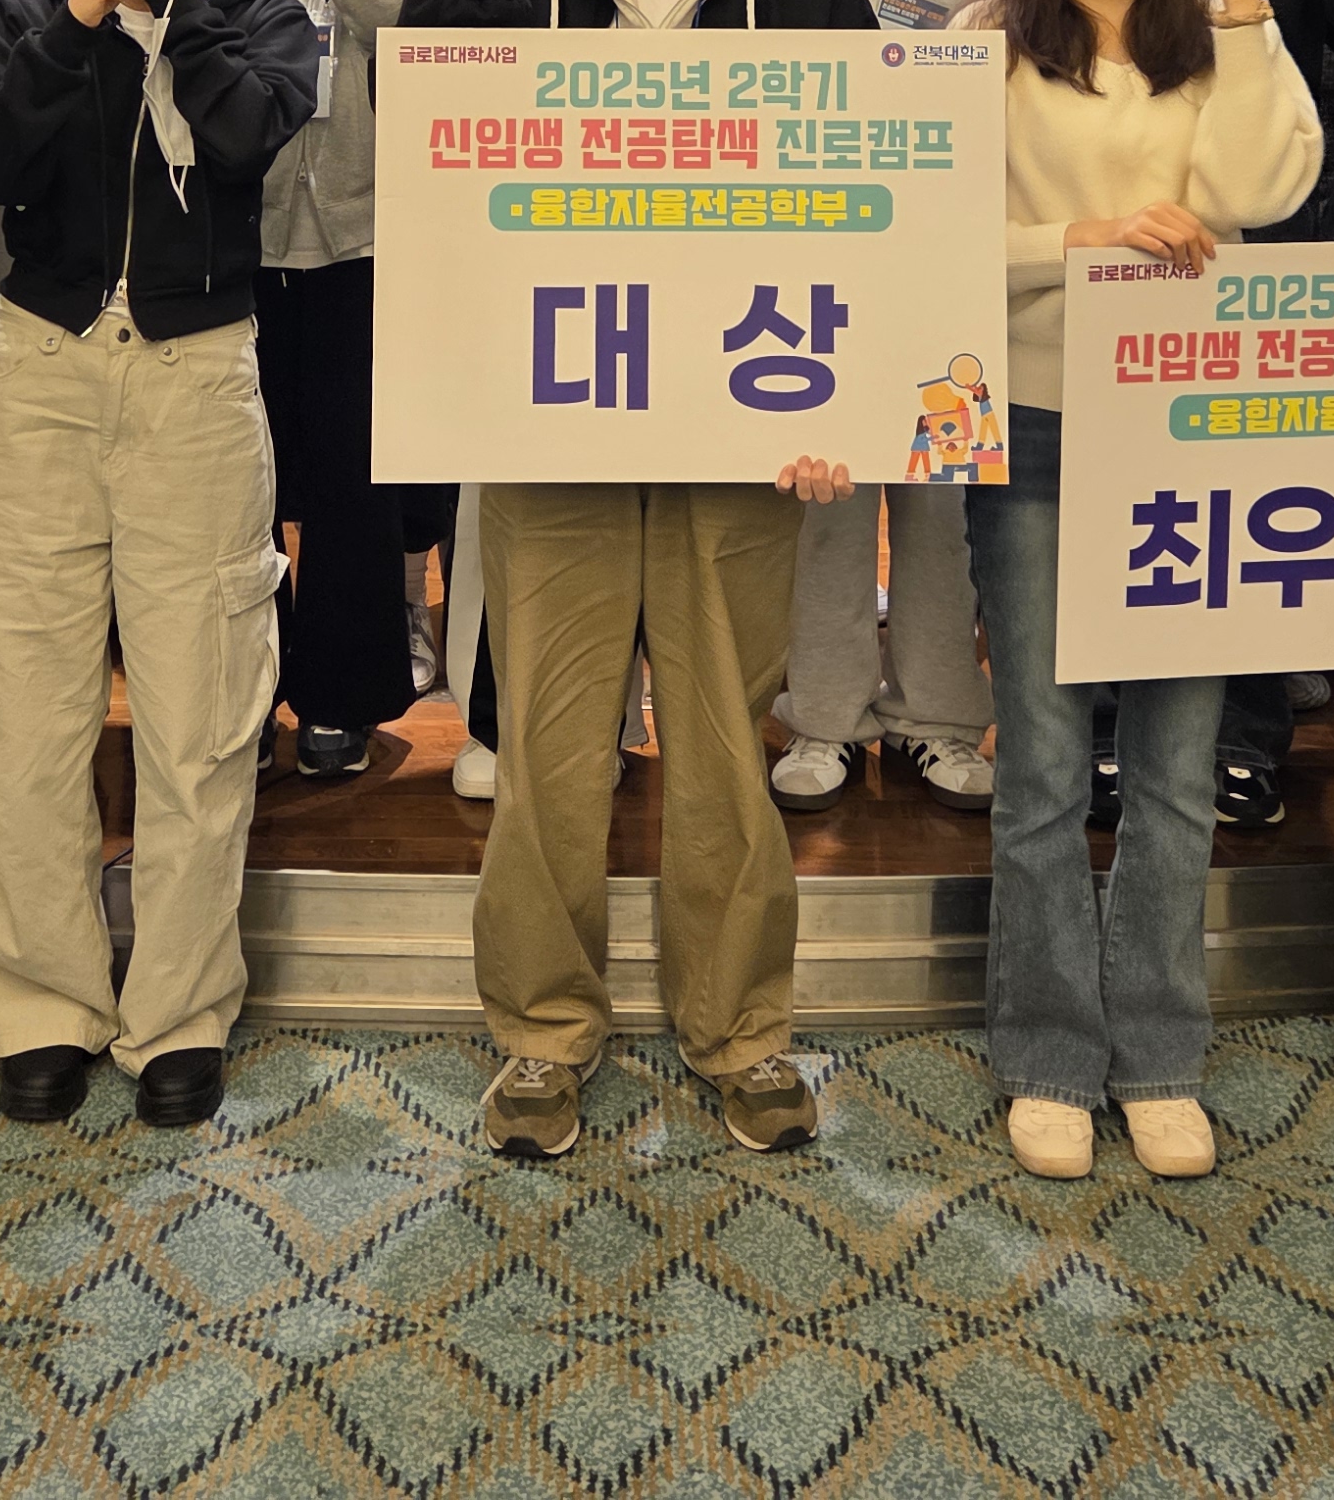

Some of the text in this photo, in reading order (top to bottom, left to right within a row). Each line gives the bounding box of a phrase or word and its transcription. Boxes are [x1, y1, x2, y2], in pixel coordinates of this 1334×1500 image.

[399, 46, 516, 63] 글로컬대학사업
[913, 45, 989, 60] 전북대학교
[536, 60, 847, 111] 2025년 2학기
[430, 119, 953, 170] 신입생 전공탐색 진로캠프
[531, 189, 846, 226] 융합자율전공학부
[1115, 331, 1240, 383] 신입생
